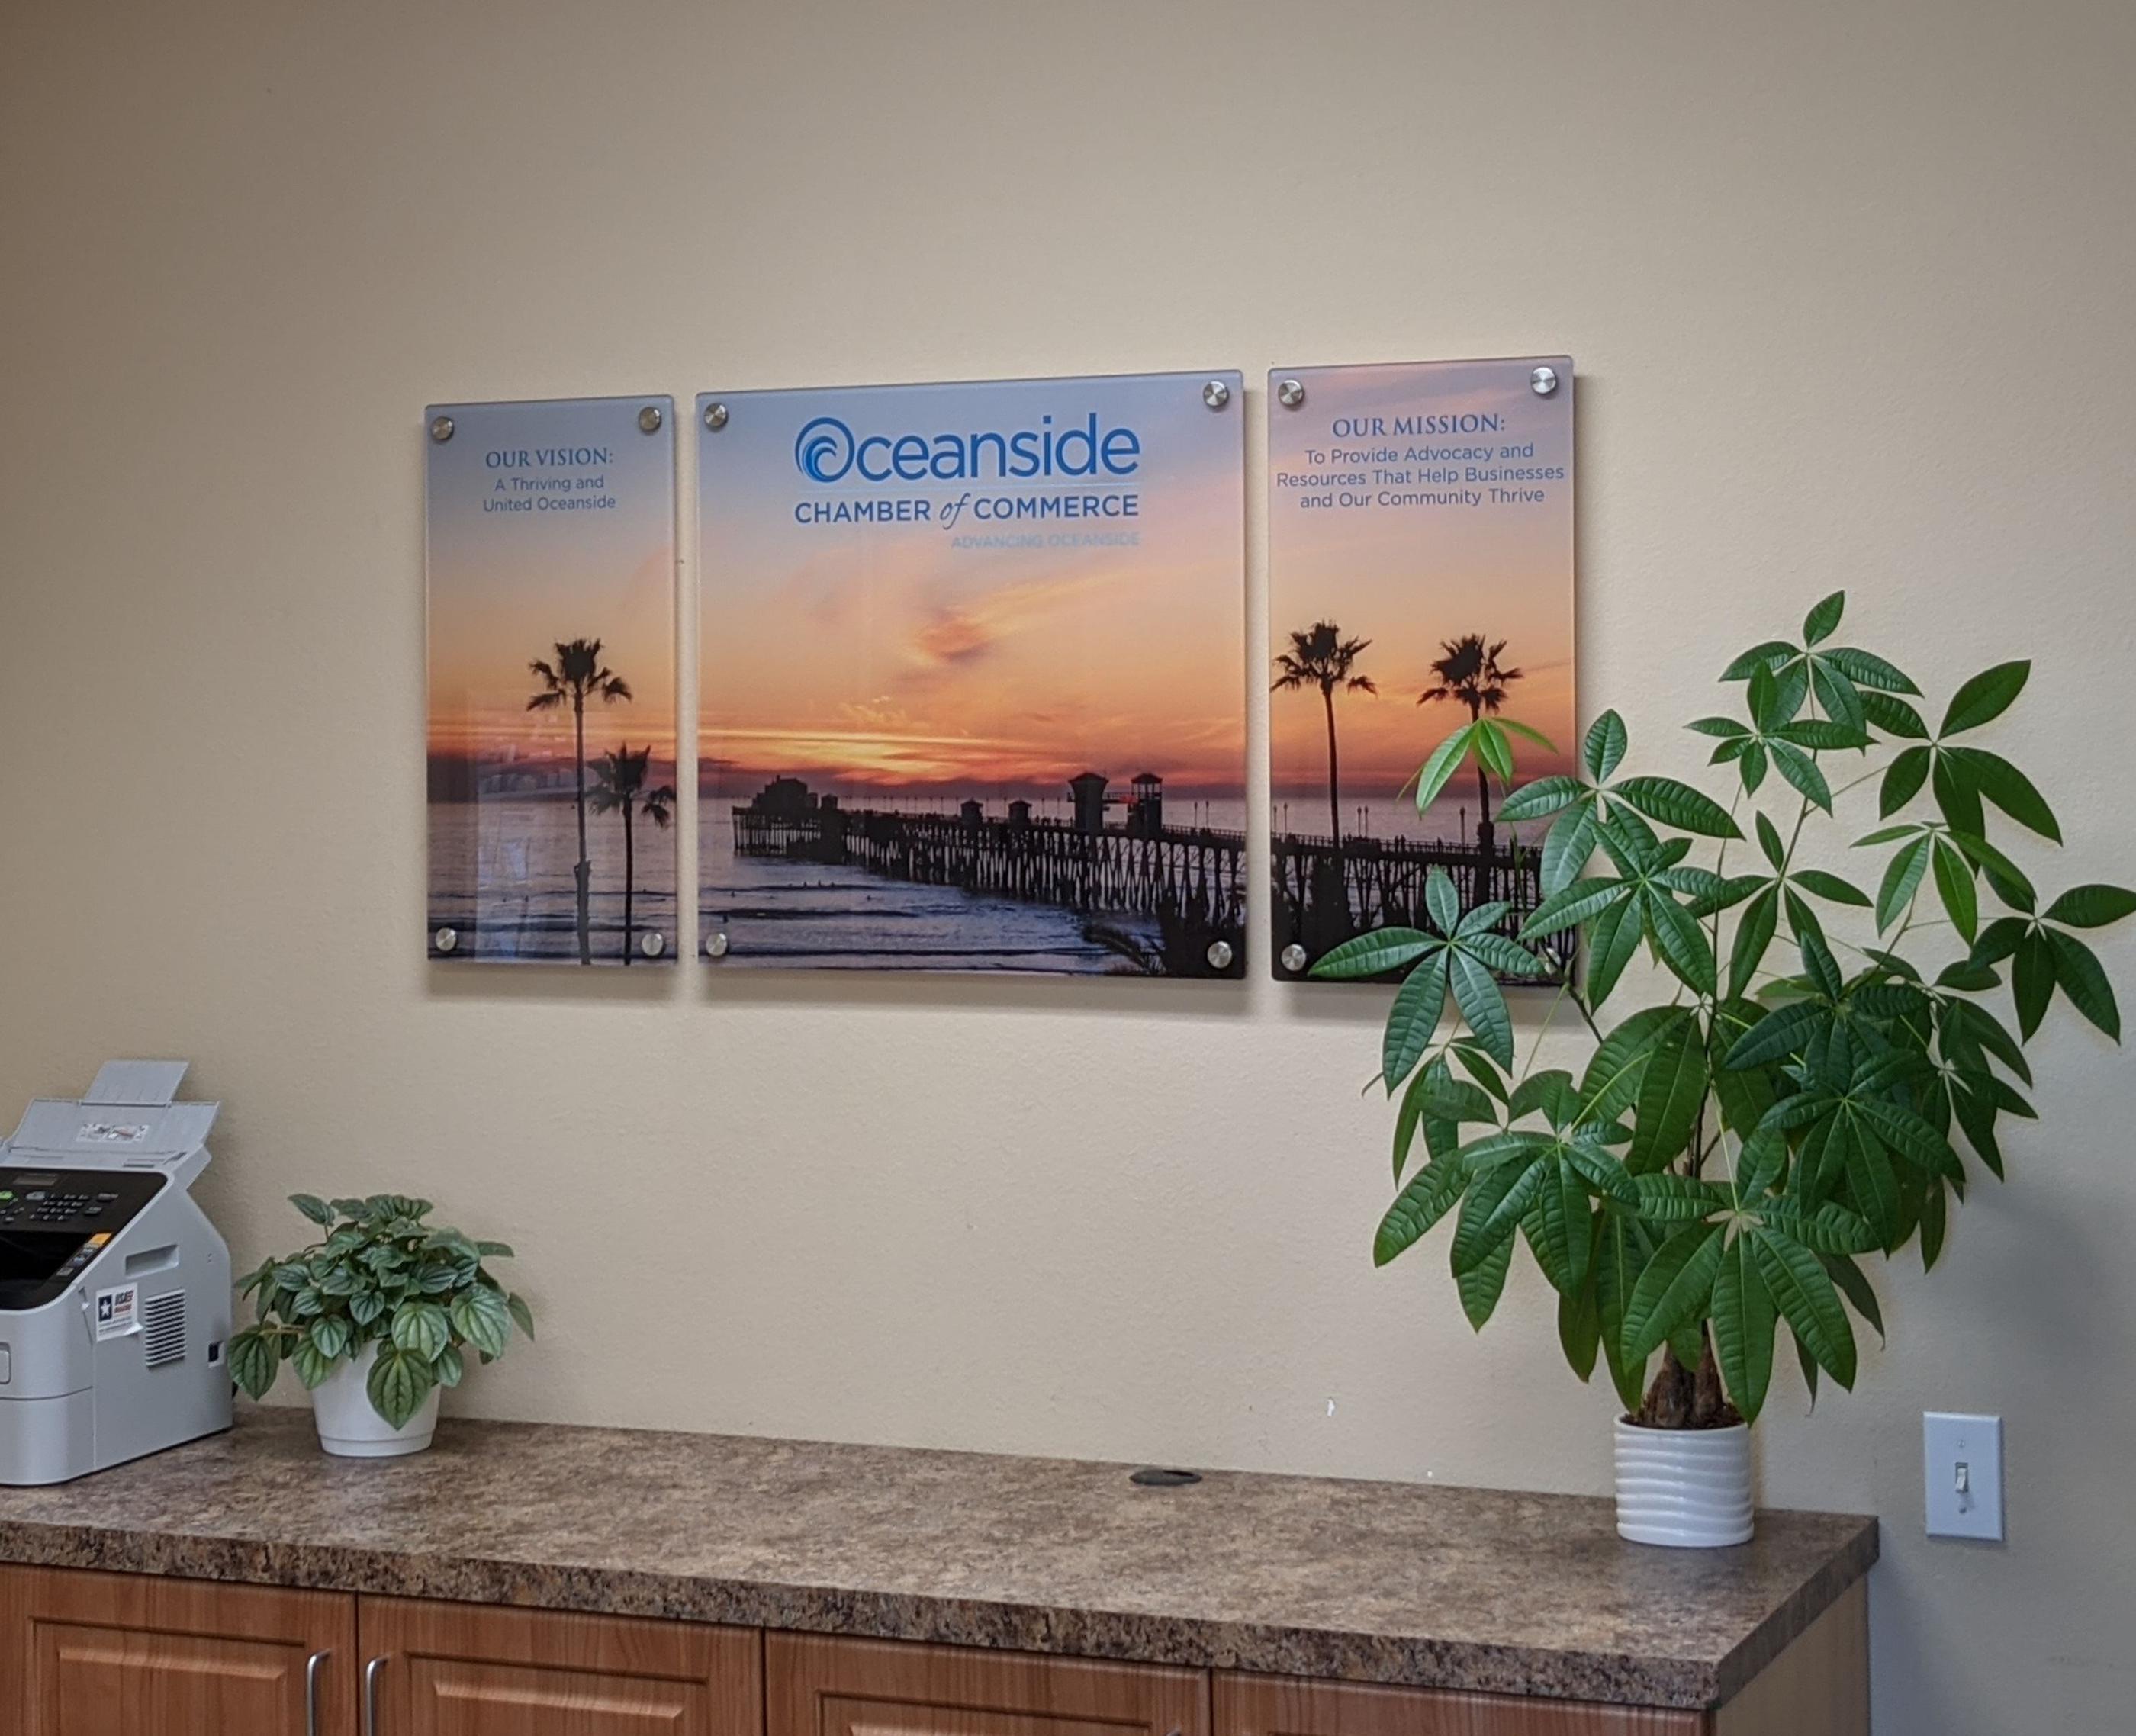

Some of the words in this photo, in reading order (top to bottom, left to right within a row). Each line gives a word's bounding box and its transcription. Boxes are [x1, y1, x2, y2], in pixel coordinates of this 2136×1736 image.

[1333, 417, 1388, 437] OUR
[1394, 413, 1506, 436] MISSION:
[485, 450, 532, 468] OUR
[536, 447, 613, 467] VISION:
[795, 412, 1140, 483] Oceanside
[1305, 449, 1326, 465] To
[1331, 446, 1398, 464] Provide
[1404, 444, 1494, 462] Advocacy
[1499, 442, 1534, 458] and
[494, 478, 506, 492] A
[511, 476, 571, 493] Thriving
[576, 474, 605, 490] and
[1277, 471, 1366, 487] Resources
[1372, 468, 1411, 484] That
[1418, 468, 1459, 486] Help
[1465, 465, 1565, 482] Businesses
[483, 497, 532, 513] United
[537, 494, 616, 511] Oceanside
[1300, 492, 1333, 508] and
[1339, 492, 1372, 507] Our
[1378, 489, 1481, 507] Community
[1488, 487, 1545, 503] Thrive
[795, 499, 931, 524] CHAMBER
[939, 493, 972, 530] of
[973, 494, 1140, 519] COMMERCE
[951, 535, 1044, 549] ADVANCING
[1048, 531, 1140, 548] OCEANSIDE
